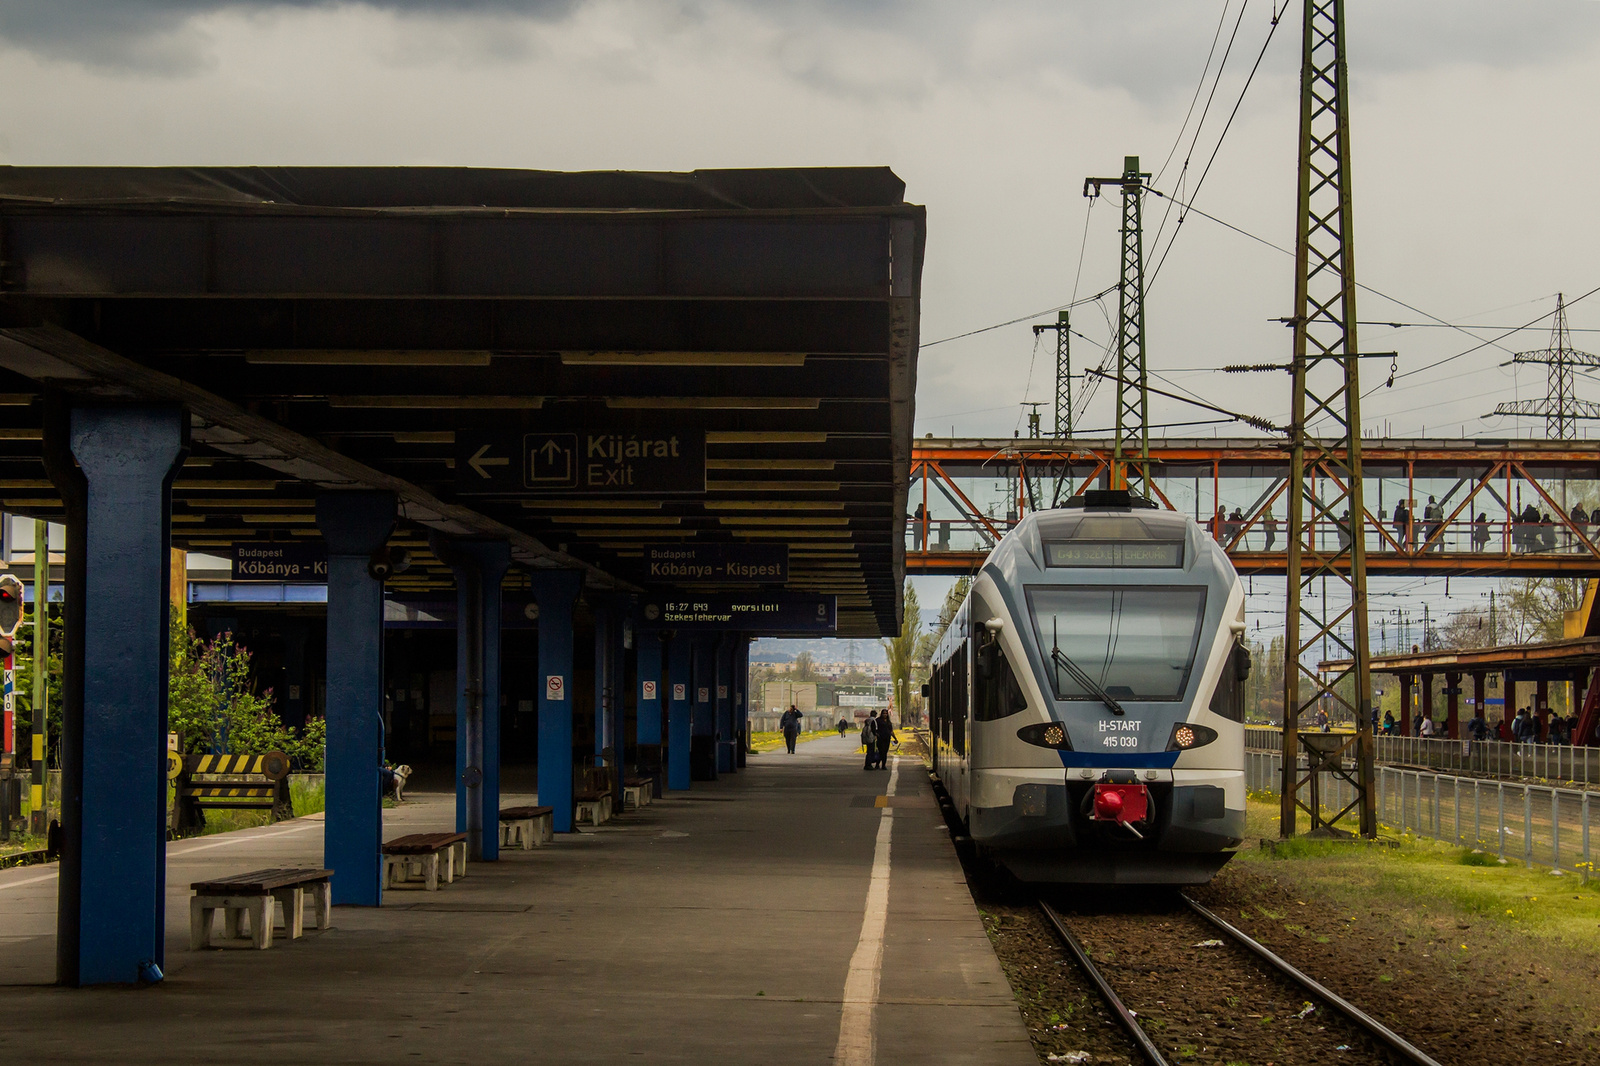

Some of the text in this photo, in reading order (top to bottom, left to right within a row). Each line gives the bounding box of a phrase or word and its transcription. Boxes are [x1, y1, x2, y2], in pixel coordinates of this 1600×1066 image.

[587, 434, 680, 464] Kijárat
[587, 464, 634, 485] Exit
[238, 548, 283, 559] Budapest
[651, 549, 696, 560] Budapest
[238, 560, 300, 577] Kőbánya
[651, 562, 712, 578] Kőbánya
[726, 562, 781, 578] Kispest
[665, 603, 689, 612] 16:27
[817, 603, 826, 616] 8
[664, 612, 732, 622] Szekesfehervar
[5, 671, 11, 682] K
[1099, 720, 1142, 732] H-START
[1103, 736, 1138, 748] 415 030
